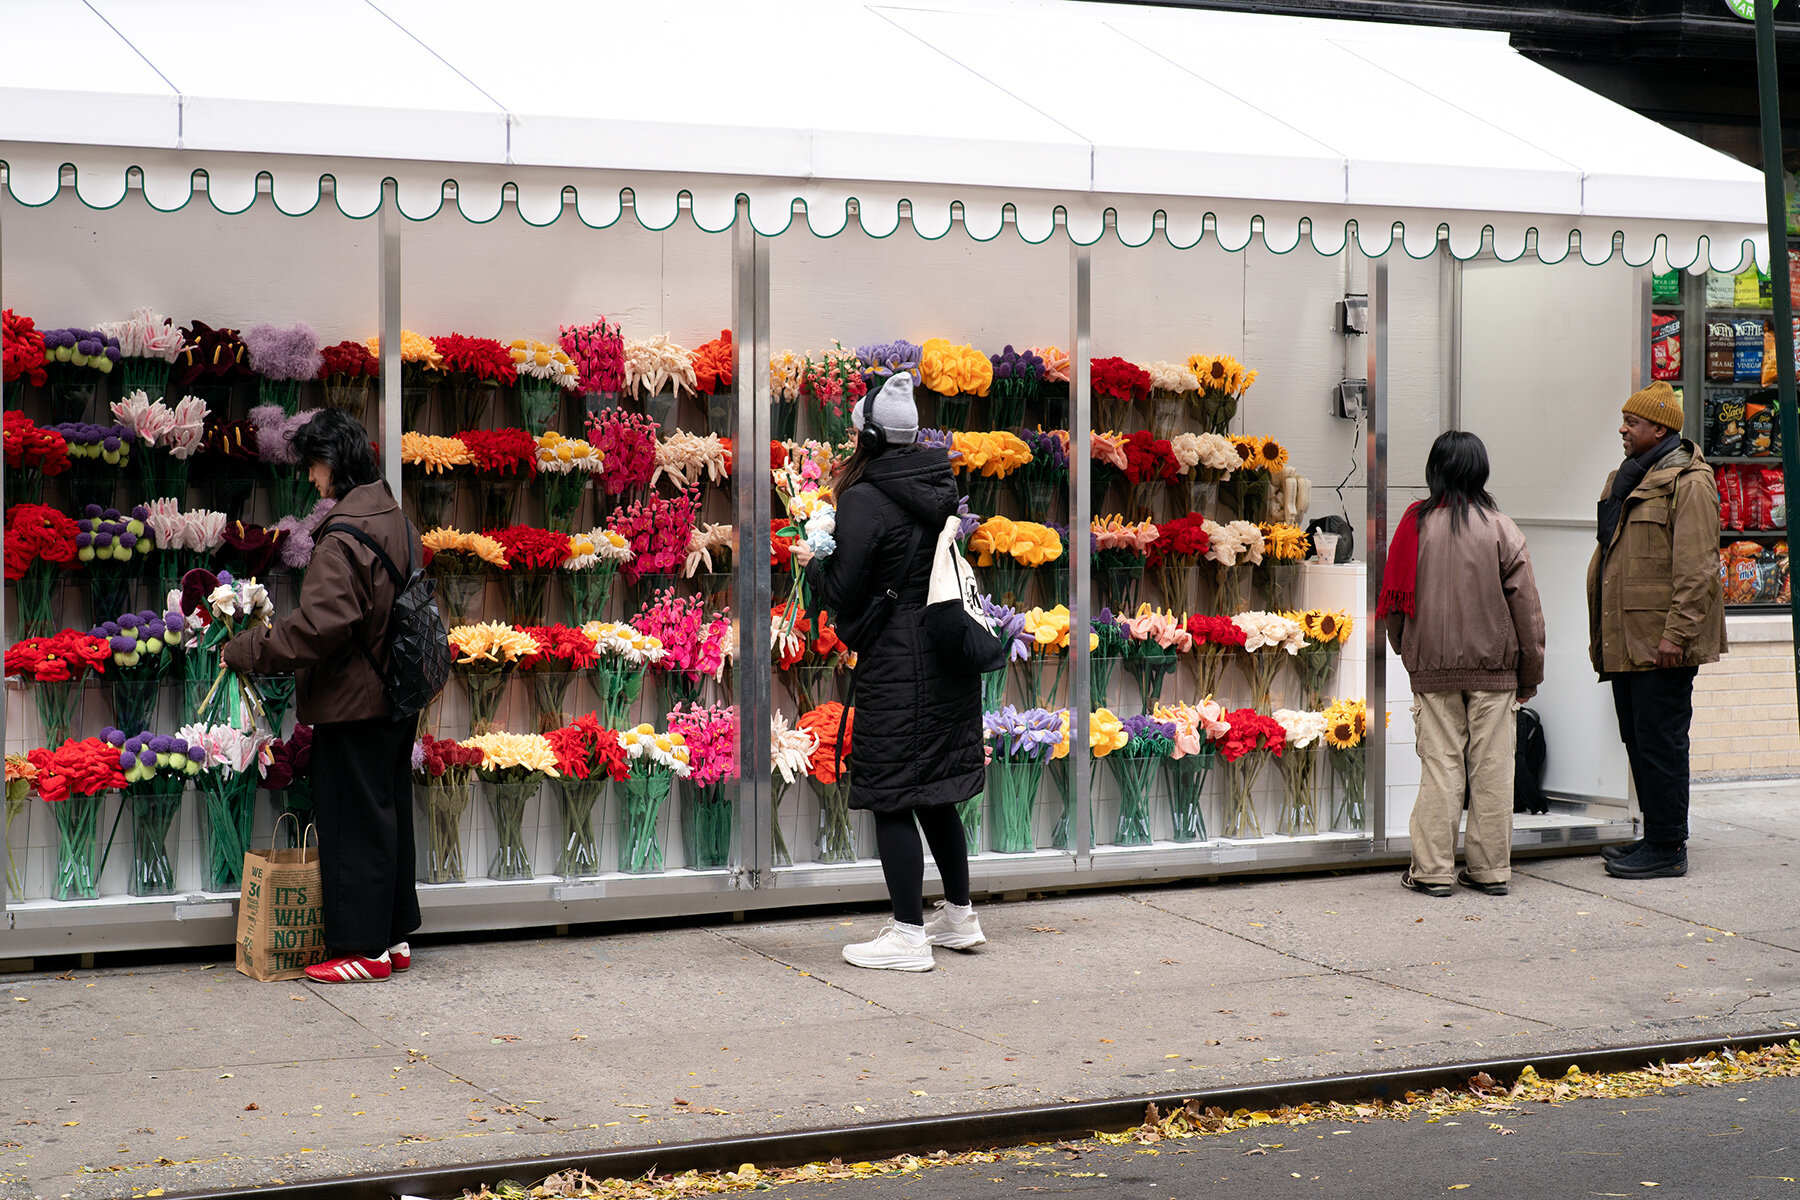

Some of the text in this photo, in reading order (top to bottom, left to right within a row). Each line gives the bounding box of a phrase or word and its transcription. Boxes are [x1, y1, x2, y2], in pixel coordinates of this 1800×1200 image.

[1736, 561, 1756, 573] Chex
[1739, 568, 1755, 580] mix
[252, 866, 263, 878] WE
[275, 887, 307, 905] IT'S
[274, 929, 308, 949] NOT
[272, 952, 305, 970] THE
